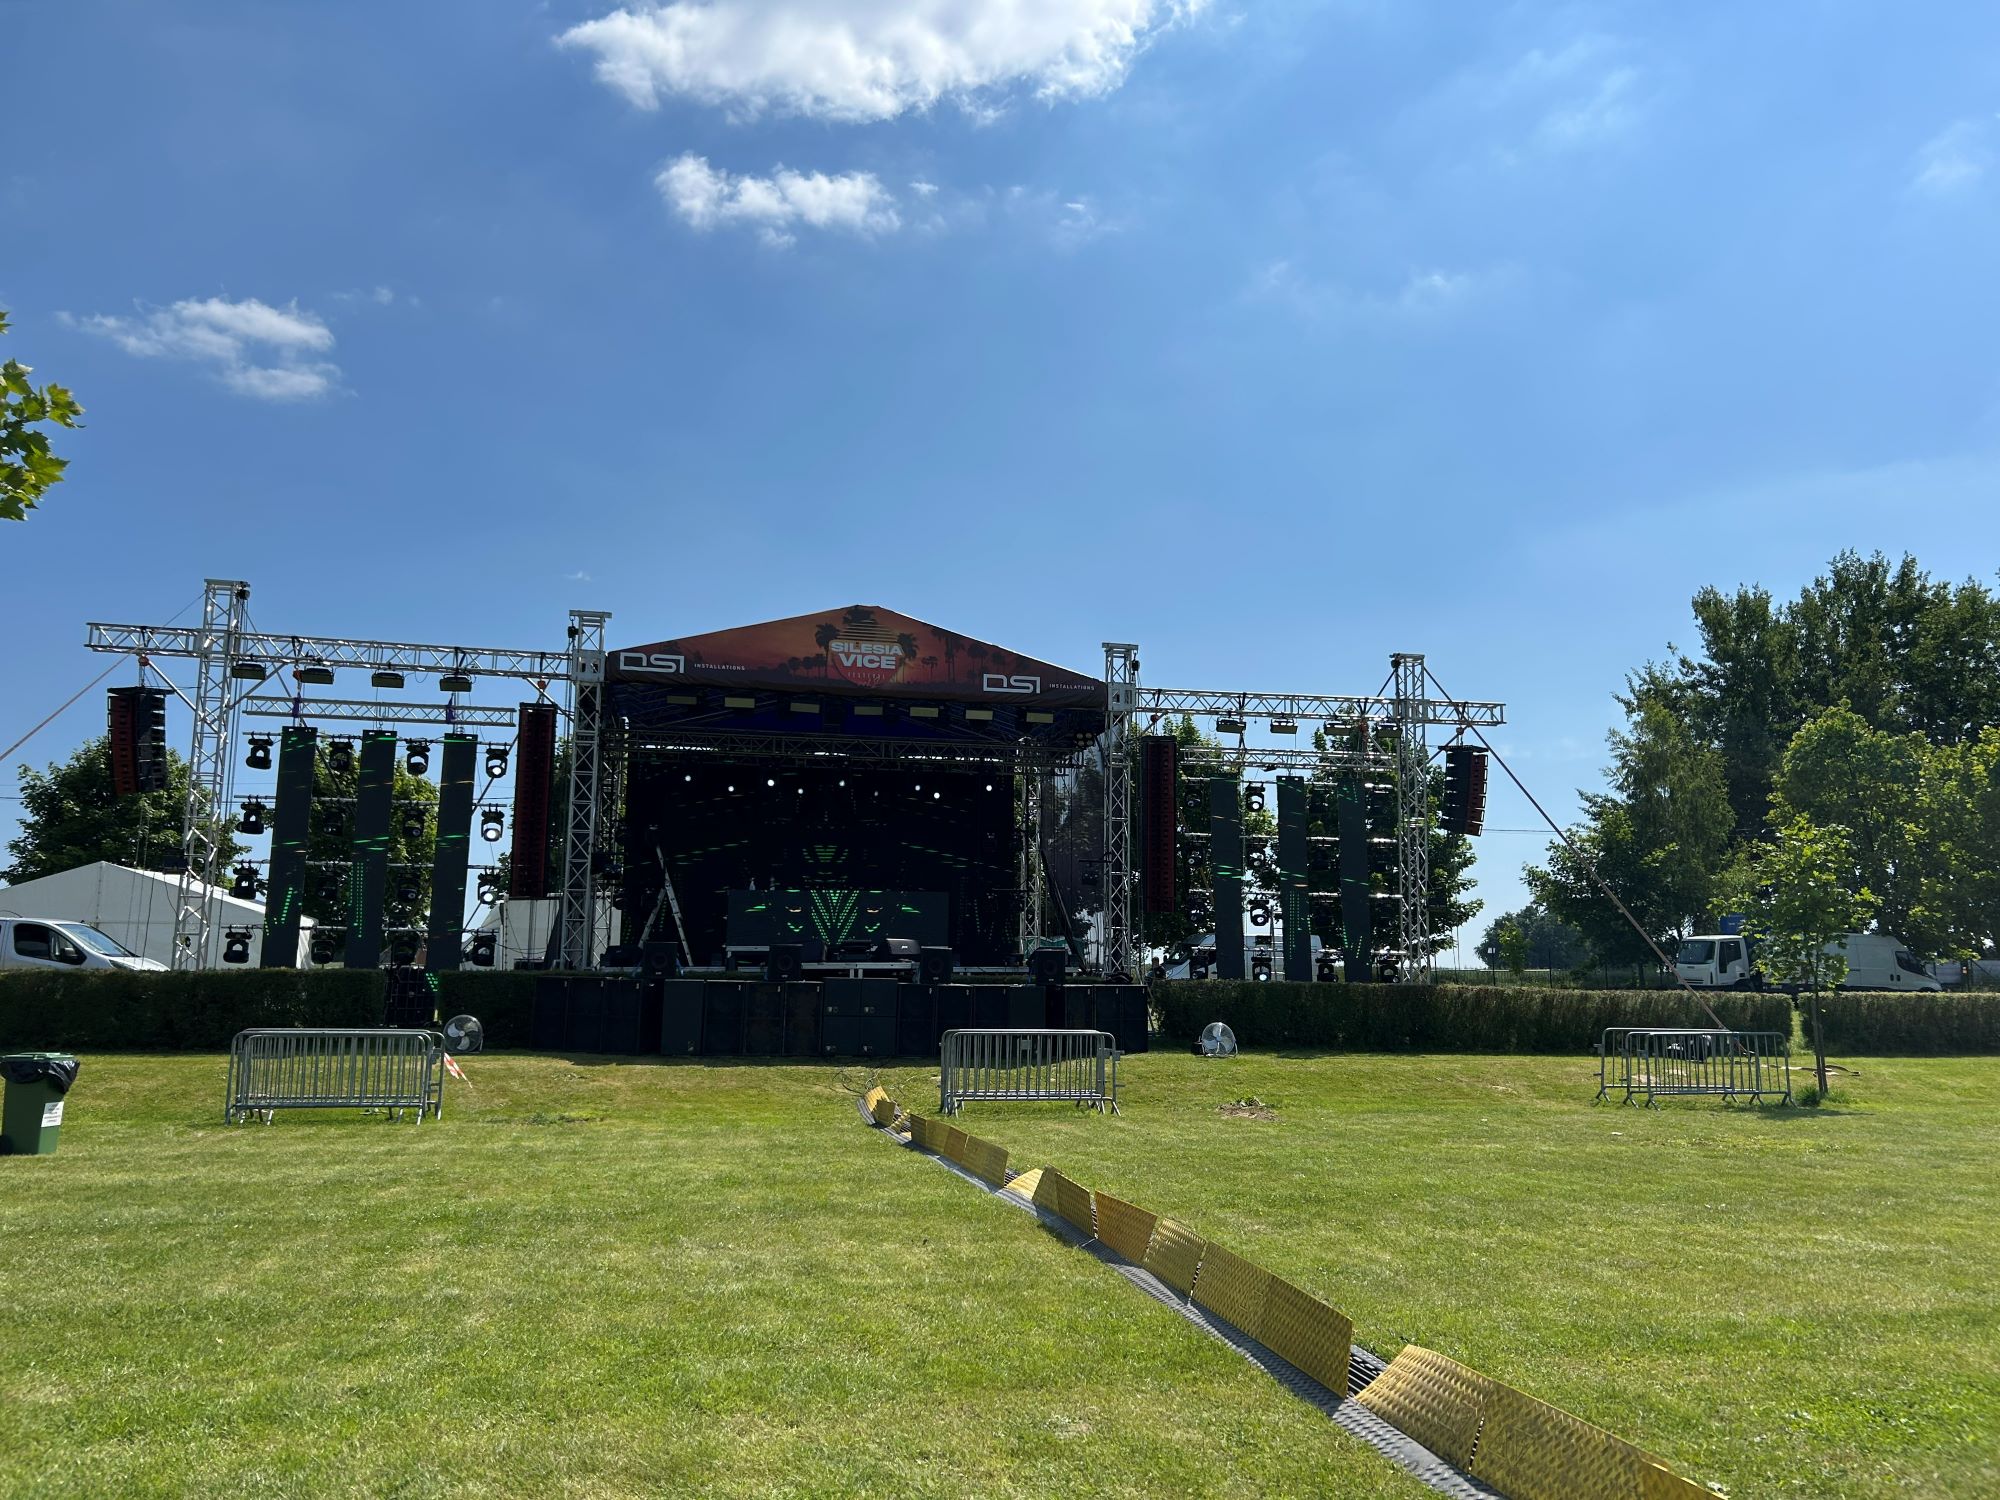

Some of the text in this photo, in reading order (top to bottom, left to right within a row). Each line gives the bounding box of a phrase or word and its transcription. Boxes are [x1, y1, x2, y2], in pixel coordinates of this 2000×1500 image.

[831, 642, 903, 655] SILESIA
[838, 653, 896, 669] VICE
[694, 663, 745, 671] INSTALLATIONS
[1049, 683, 1095, 691] INSTALLATIONS
